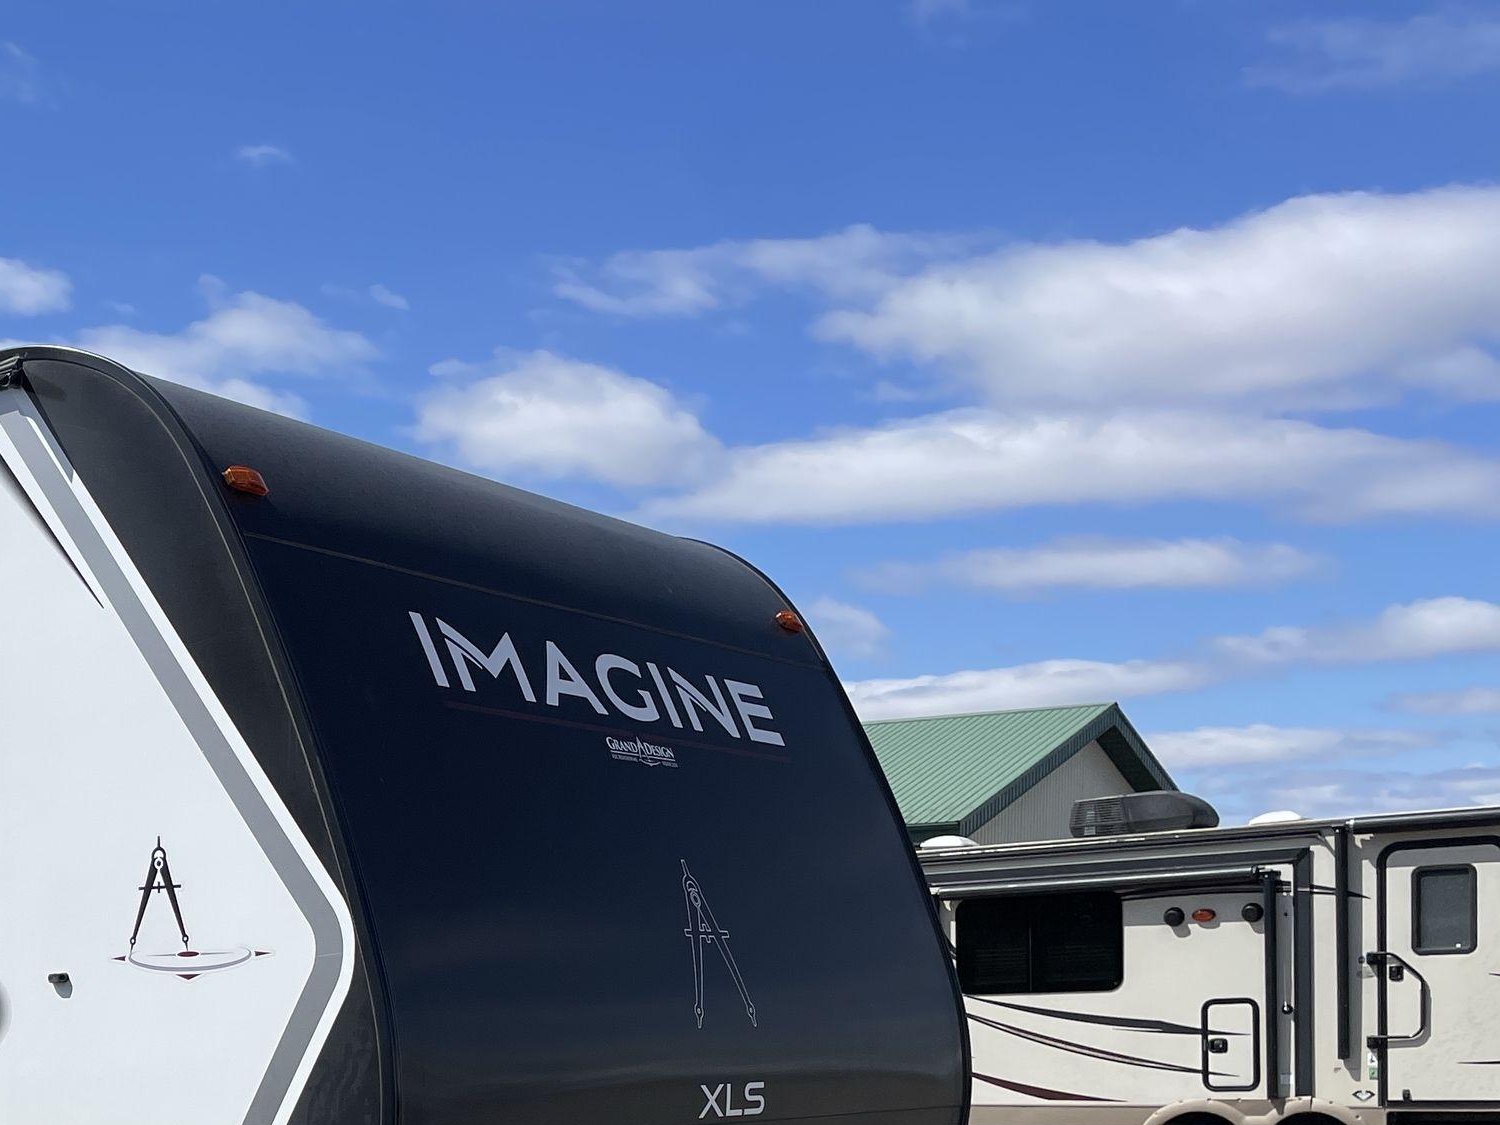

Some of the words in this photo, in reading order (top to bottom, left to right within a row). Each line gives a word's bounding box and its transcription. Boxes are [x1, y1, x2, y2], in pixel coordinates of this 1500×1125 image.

[408, 610, 786, 747] IMAGINE
[605, 736, 638, 753] GRAND
[642, 741, 675, 759] DESIGN
[698, 1081, 765, 1119] XLS
